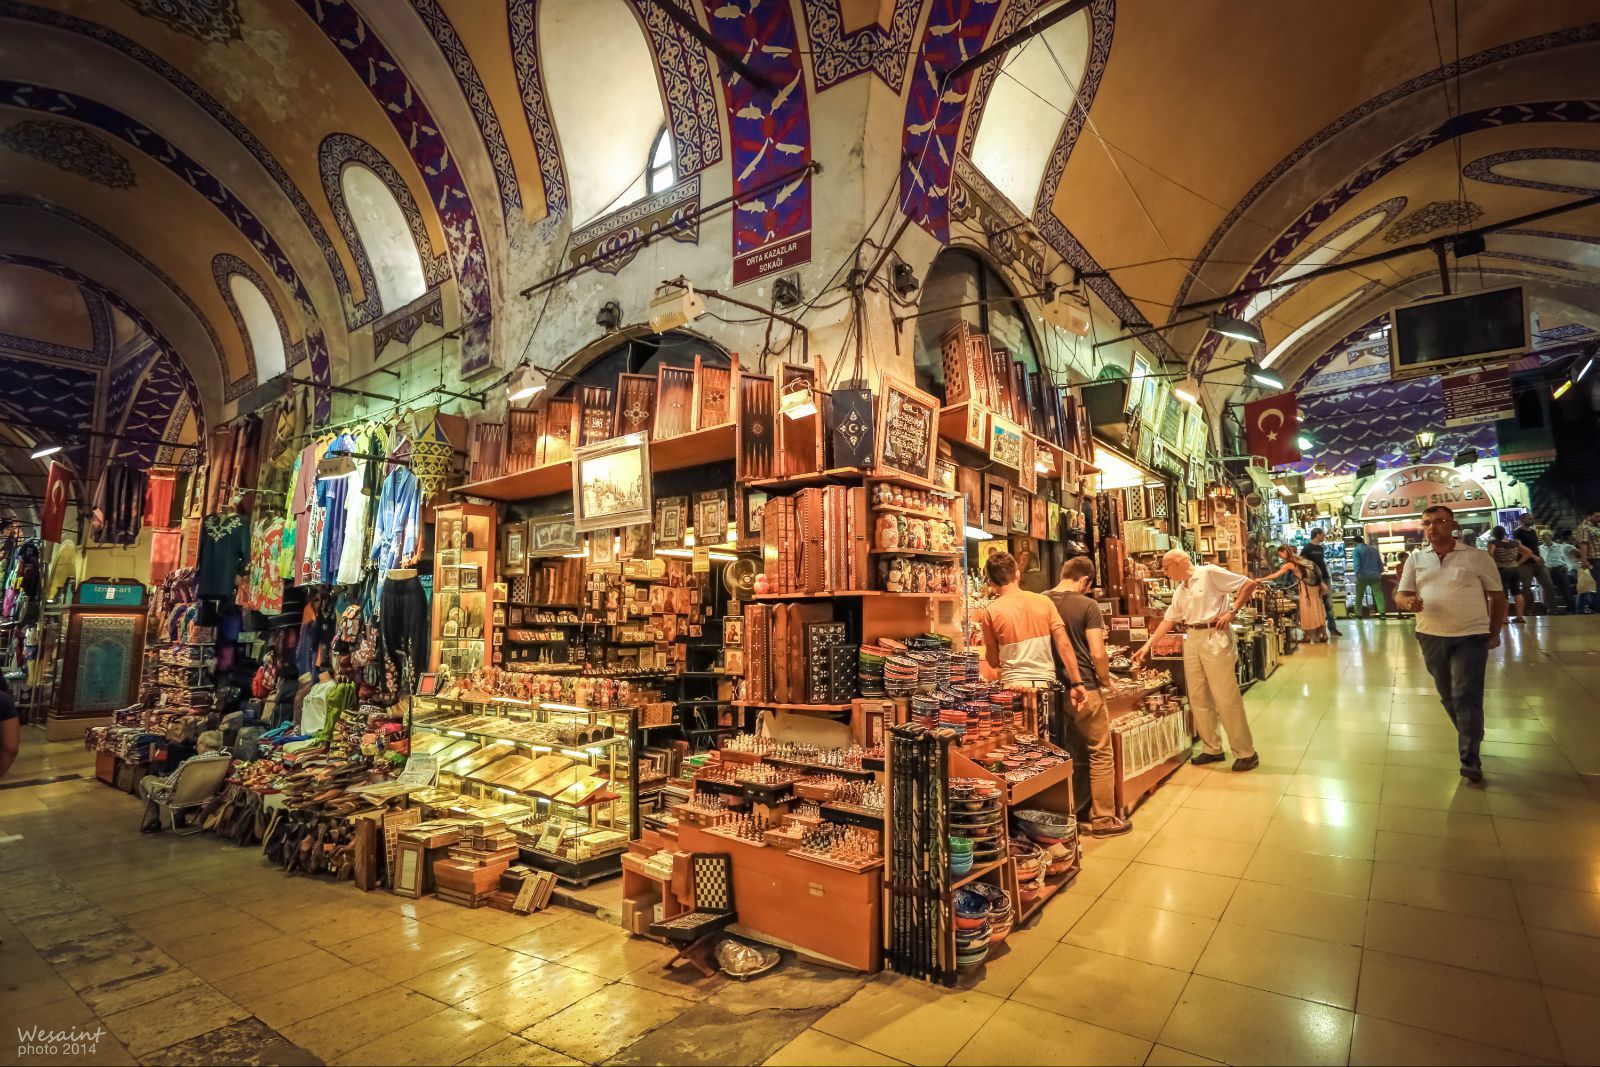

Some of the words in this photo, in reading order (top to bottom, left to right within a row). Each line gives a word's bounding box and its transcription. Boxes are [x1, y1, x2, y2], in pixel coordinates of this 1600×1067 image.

[746, 255, 763, 266] ORTA
[763, 242, 797, 260] KAZAZLAR
[759, 258, 783, 272] SOKAĞI
[1367, 497, 1410, 510] GOLD
[1430, 489, 1484, 504] SILVER
